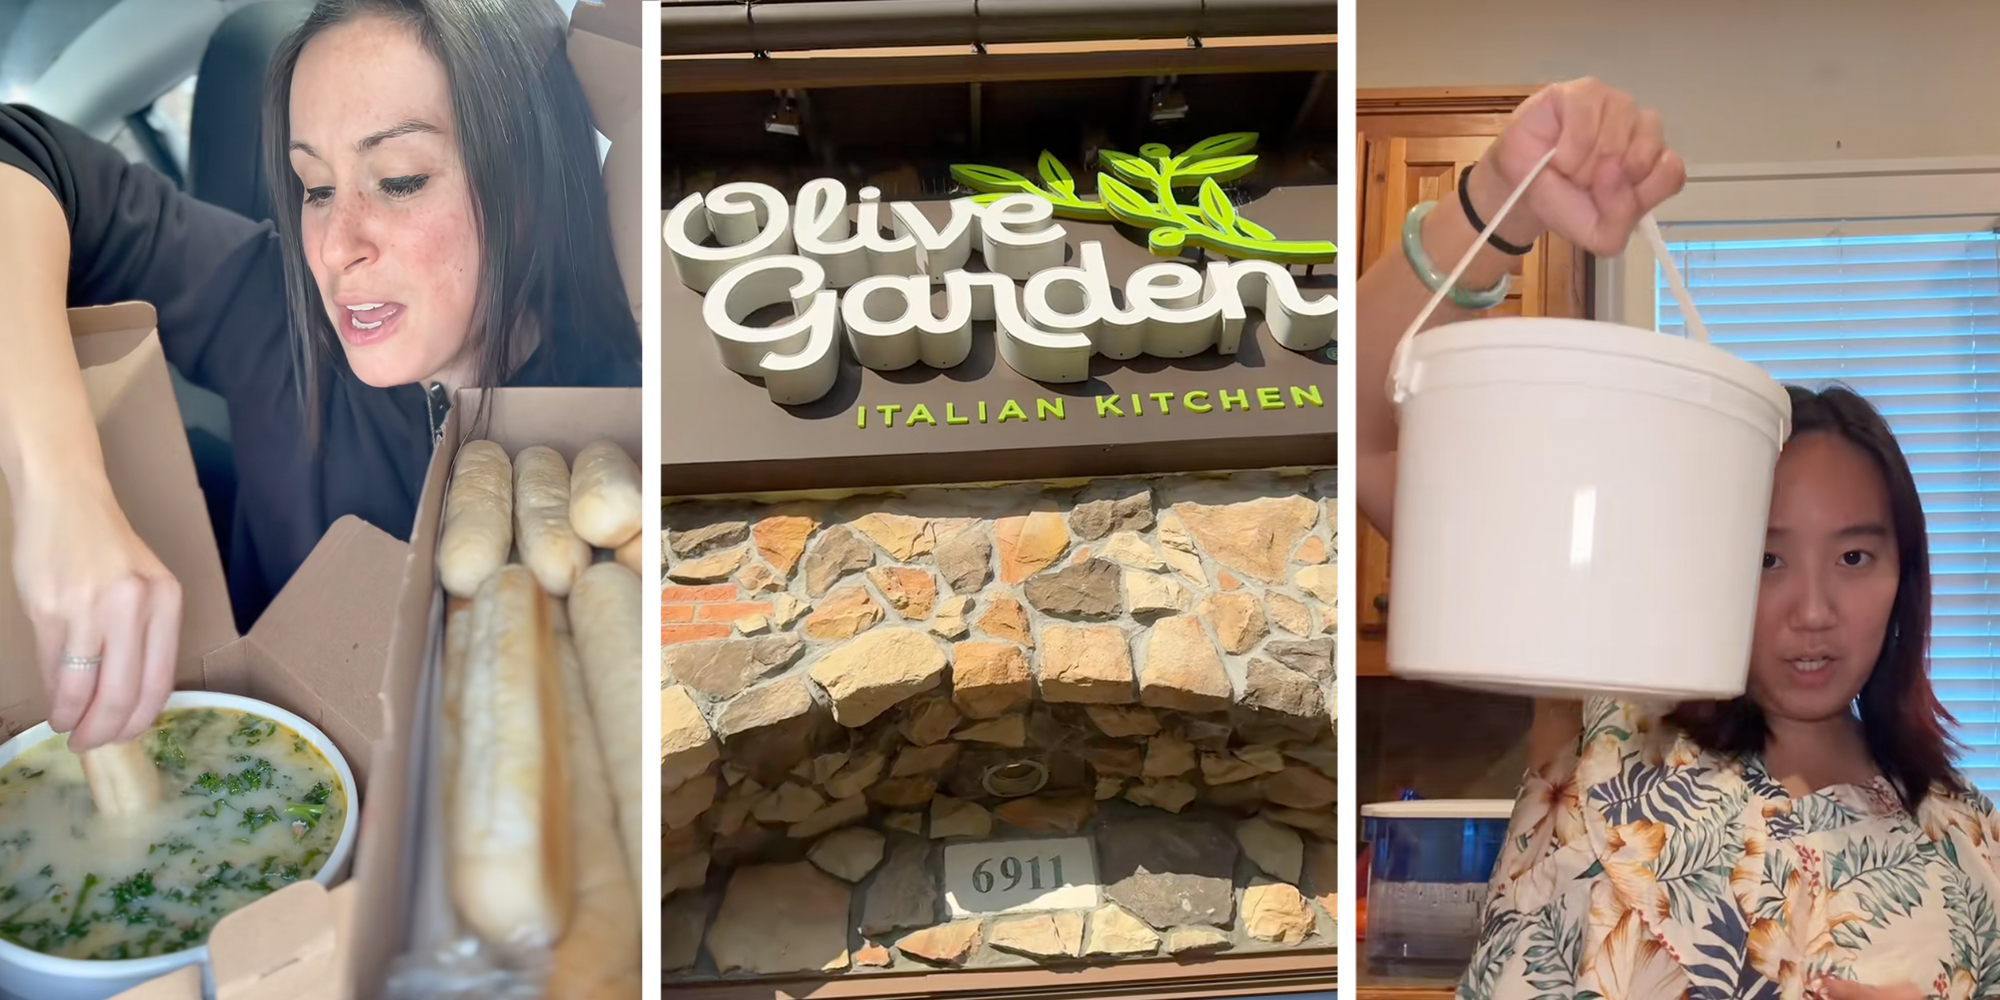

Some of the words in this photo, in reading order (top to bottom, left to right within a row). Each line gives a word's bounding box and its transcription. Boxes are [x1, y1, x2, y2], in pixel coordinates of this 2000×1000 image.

[662, 177, 1067, 278] Olive
[702, 240, 1338, 394] Garden
[857, 396, 1066, 429] ITALIAN
[1095, 384, 1324, 417] KITCHEN
[972, 855, 1064, 893] 6911
